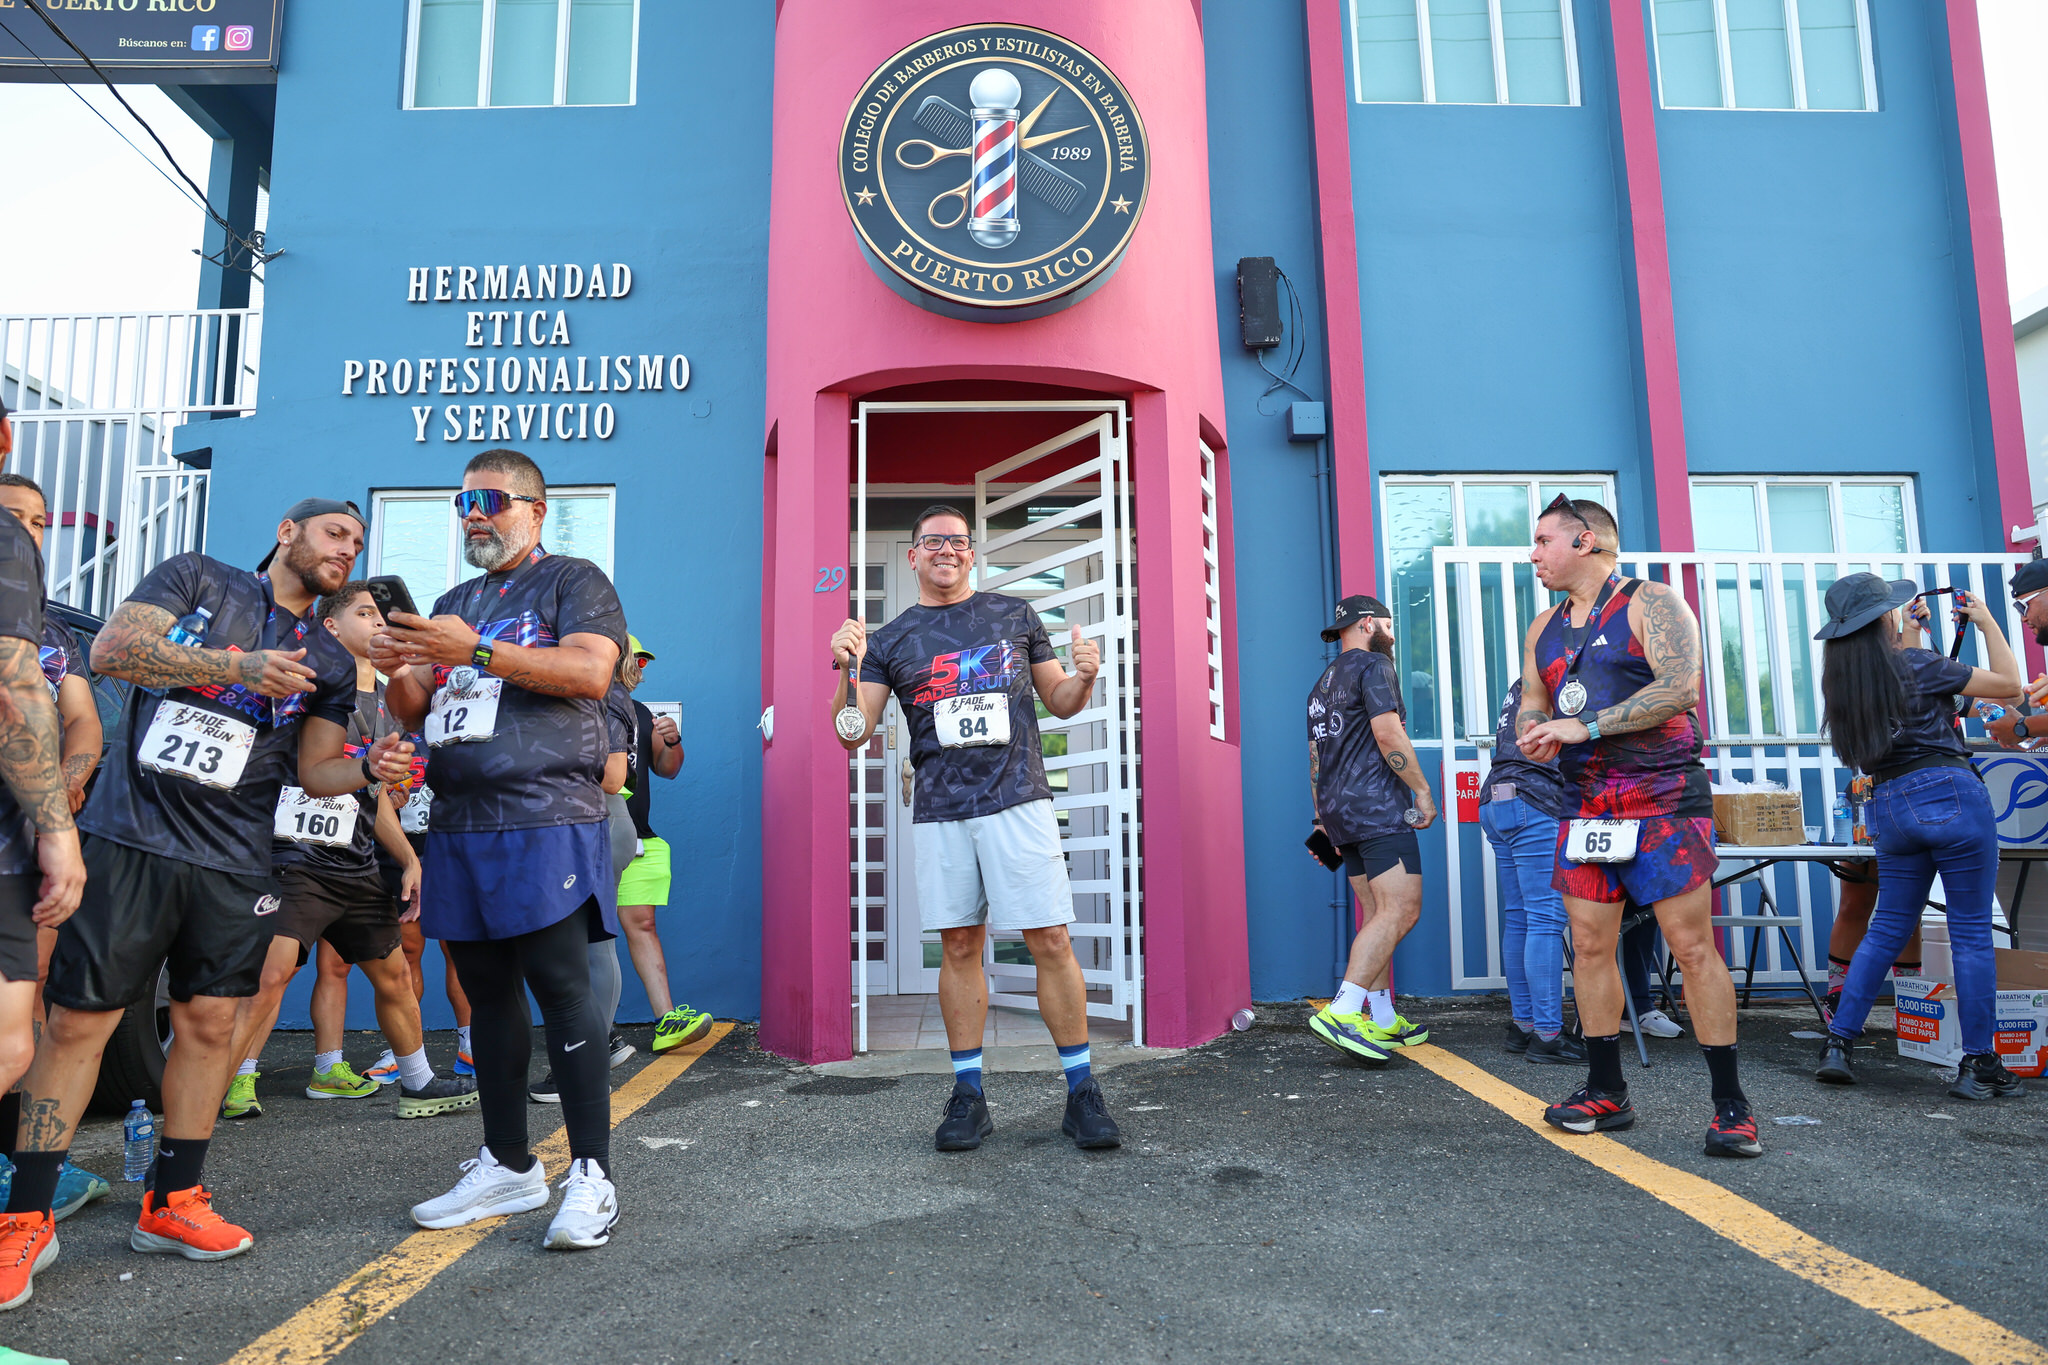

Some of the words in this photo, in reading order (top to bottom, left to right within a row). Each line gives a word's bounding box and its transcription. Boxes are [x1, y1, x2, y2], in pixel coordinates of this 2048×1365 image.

[118, 37, 168, 48] Búscanos
[170, 40, 187, 48] en:
[853, 102, 882, 173] COLEGIO
[875, 80, 899, 104] DE
[894, 39, 977, 85] BARBEROS
[980, 38, 991, 51] Y
[995, 38, 1085, 78] ESTILISTAS
[1081, 73, 1106, 95] EN
[1098, 93, 1135, 173] BARBERÍA
[1050, 146, 1092, 161] 1989
[890, 239, 1014, 293] PUERTO
[1022, 246, 1095, 290] RICO
[407, 263, 633, 302] HERMANDAD
[465, 309, 571, 347] ETICA
[341, 354, 691, 395] PROFESIONALISMO
[411, 406, 432, 442] Y
[443, 402, 615, 442] SERVICIO
[814, 566, 846, 593] 29
[928, 644, 998, 687] 5K
[913, 683, 958, 706] FADE
[959, 681, 972, 695] &
[960, 696, 985, 706] FADE
[973, 703, 994, 712] RUN
[188, 711, 228, 729] FADE
[443, 706, 468, 734] 12
[959, 716, 989, 738] 84
[202, 726, 235, 742] RUN
[157, 734, 223, 774] 213
[322, 802, 345, 811] RUN
[294, 811, 339, 837] 160
[1585, 831, 1612, 853] 65
[1896, 981, 1929, 991] MARATHON
[1898, 998, 1919, 1011] 6,000
[1899, 1017, 1919, 1026] JUMBO
[1919, 1020, 1935, 1030] 2-PLY
[1899, 1025, 1918, 1035] TOILET
[1918, 1029, 1937, 1039] PAPER
[1998, 1021, 2017, 1029] 6,000
